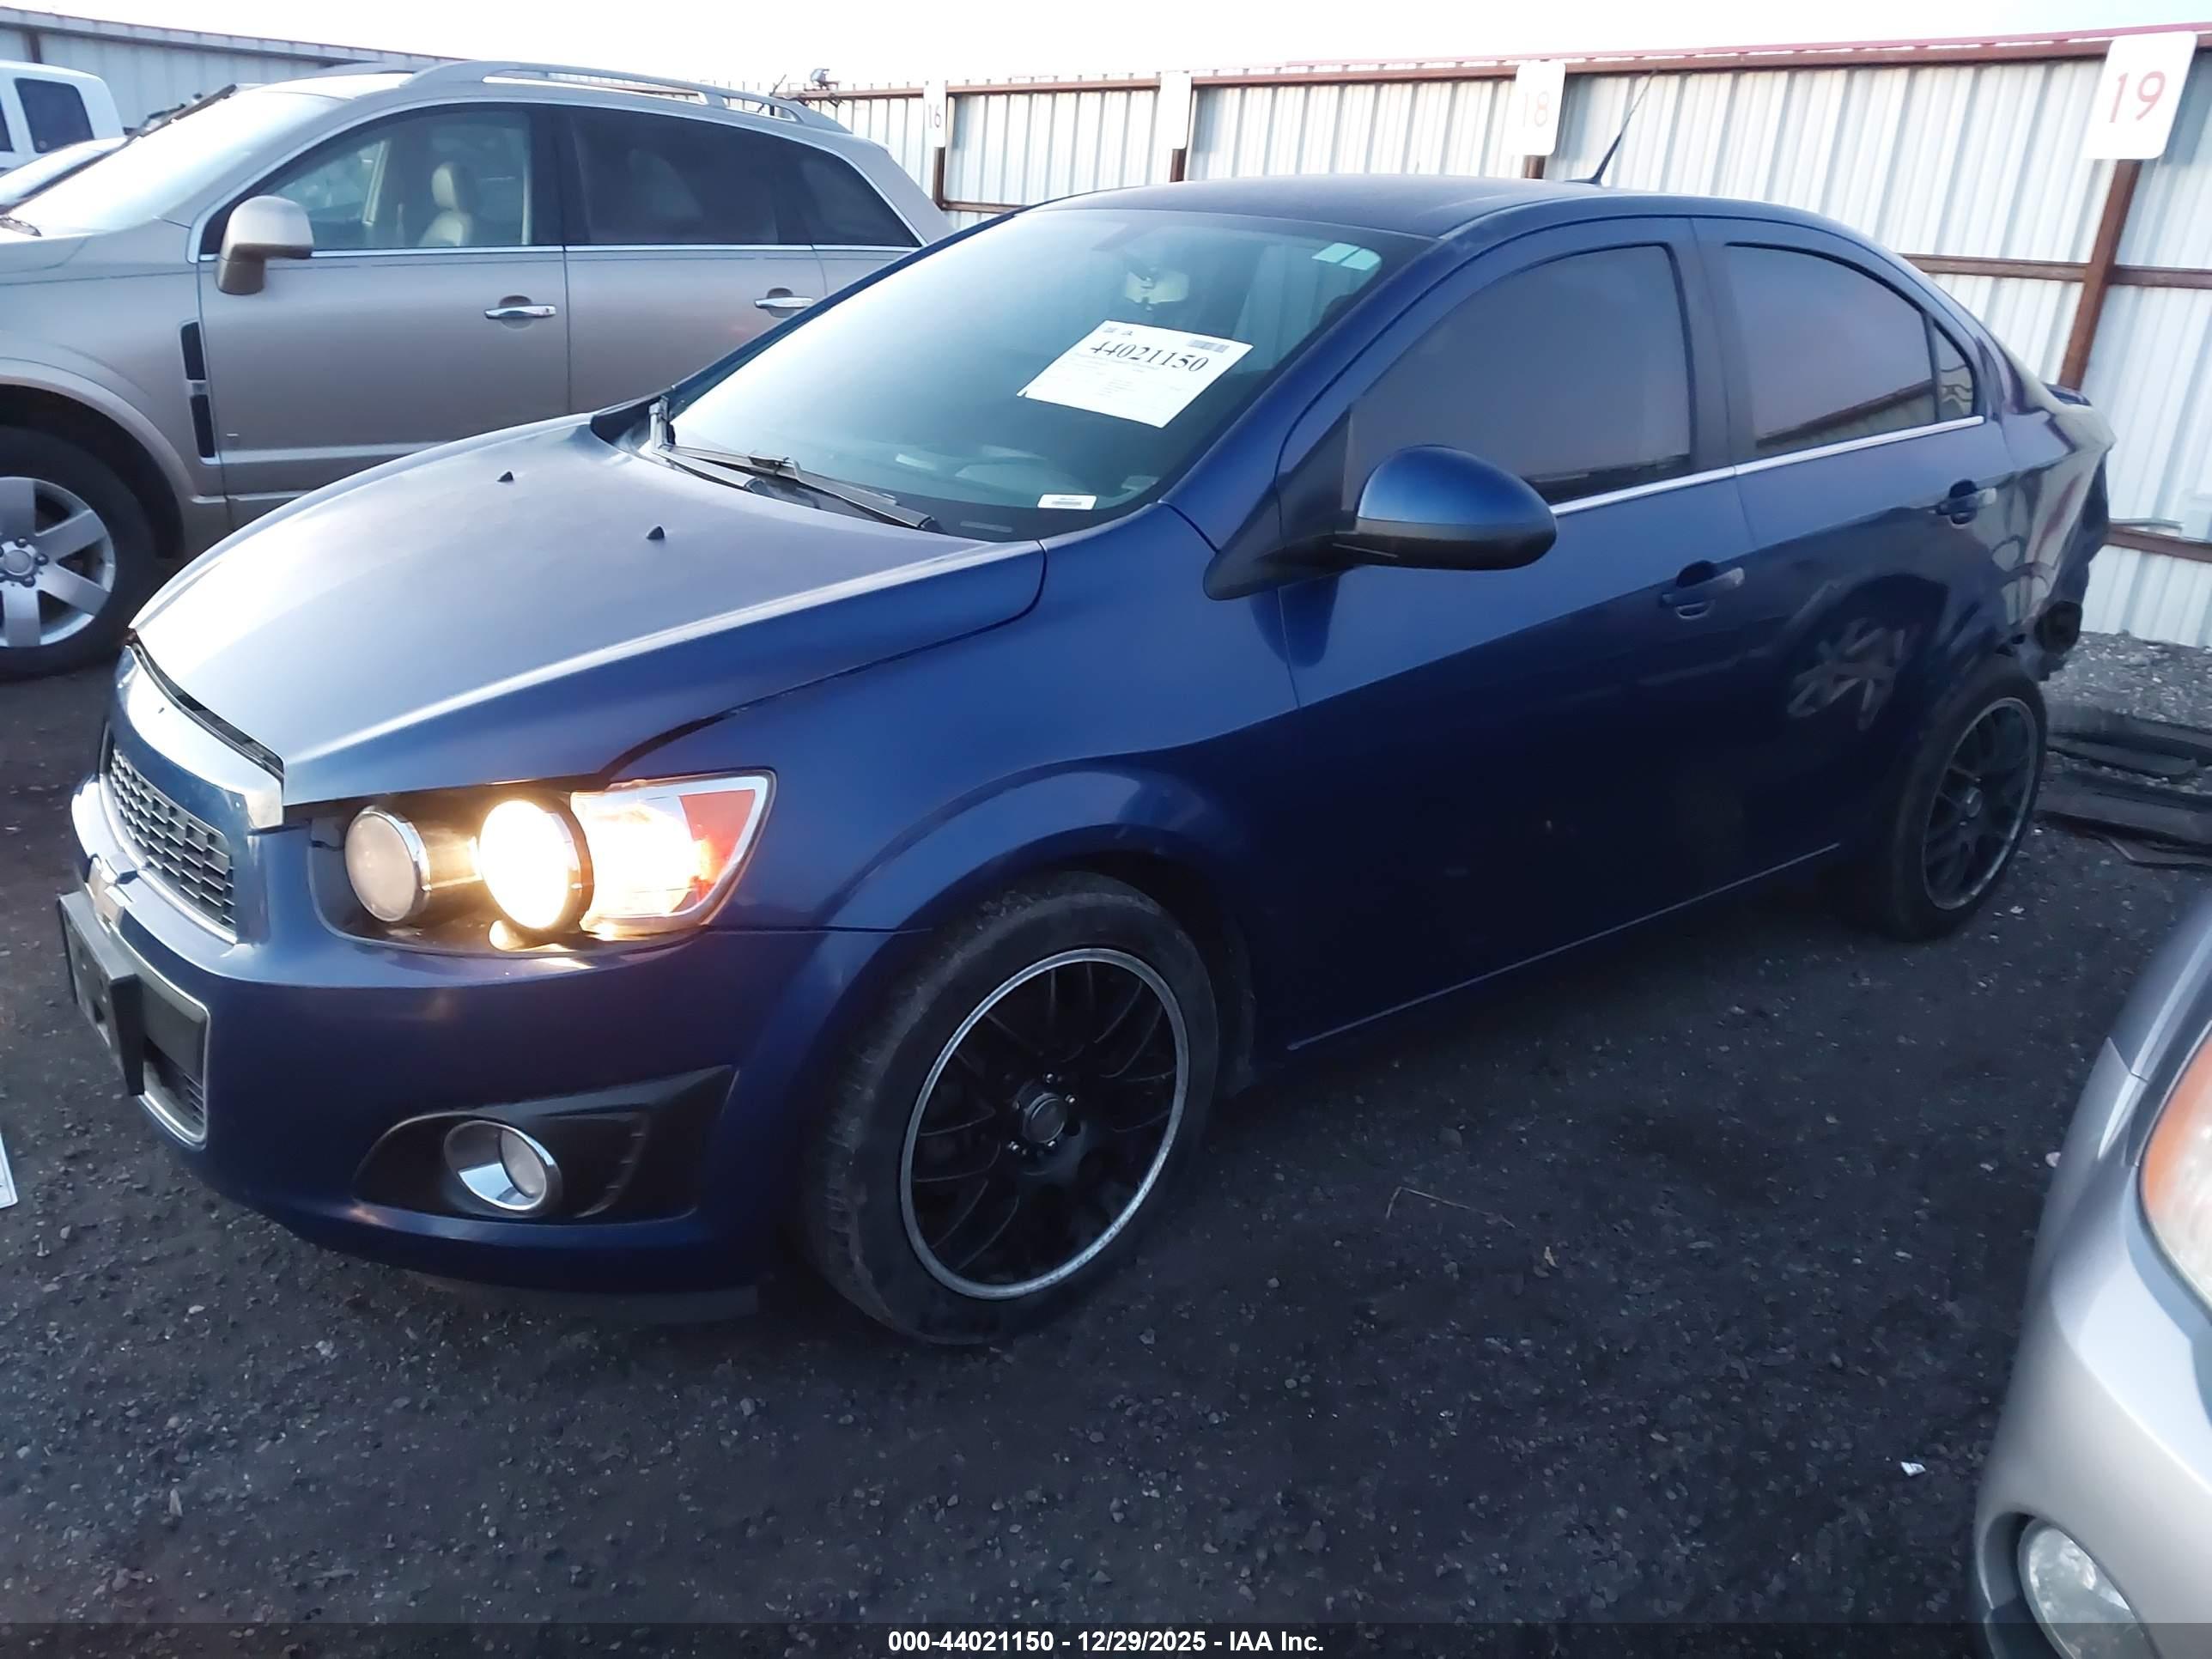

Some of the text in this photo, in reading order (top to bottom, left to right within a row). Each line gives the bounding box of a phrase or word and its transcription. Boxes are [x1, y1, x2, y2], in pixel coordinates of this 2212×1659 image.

[1522, 90, 1549, 128] 18
[2109, 70, 2166, 124] 19
[928, 103, 942, 129] 16
[1090, 340, 1210, 372] 44021150
